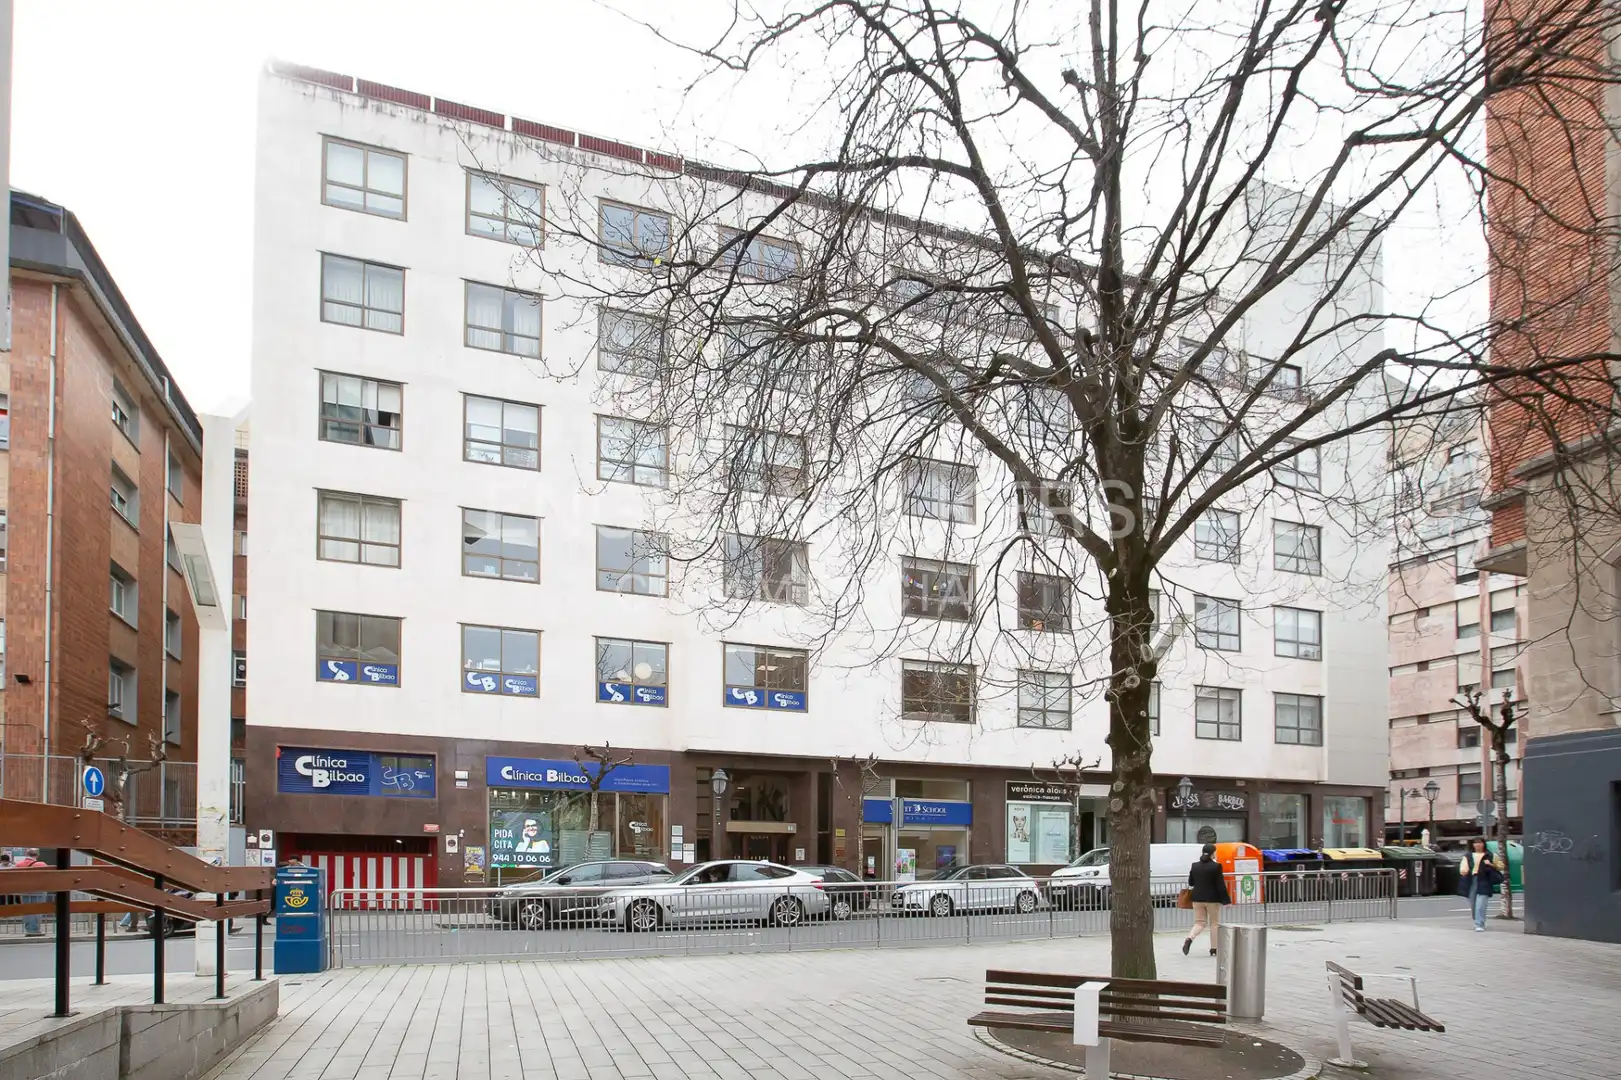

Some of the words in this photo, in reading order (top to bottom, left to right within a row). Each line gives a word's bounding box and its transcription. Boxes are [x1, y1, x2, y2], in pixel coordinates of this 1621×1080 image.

[295, 755, 347, 776] Clínica
[312, 769, 365, 788] Bilbao
[501, 765, 543, 781] Clínica
[546, 769, 588, 784] Bilbao
[494, 829, 513, 838] PIDA
[494, 840, 513, 849] CITA
[492, 854, 510, 862] 944
[539, 855, 551, 863] 06
